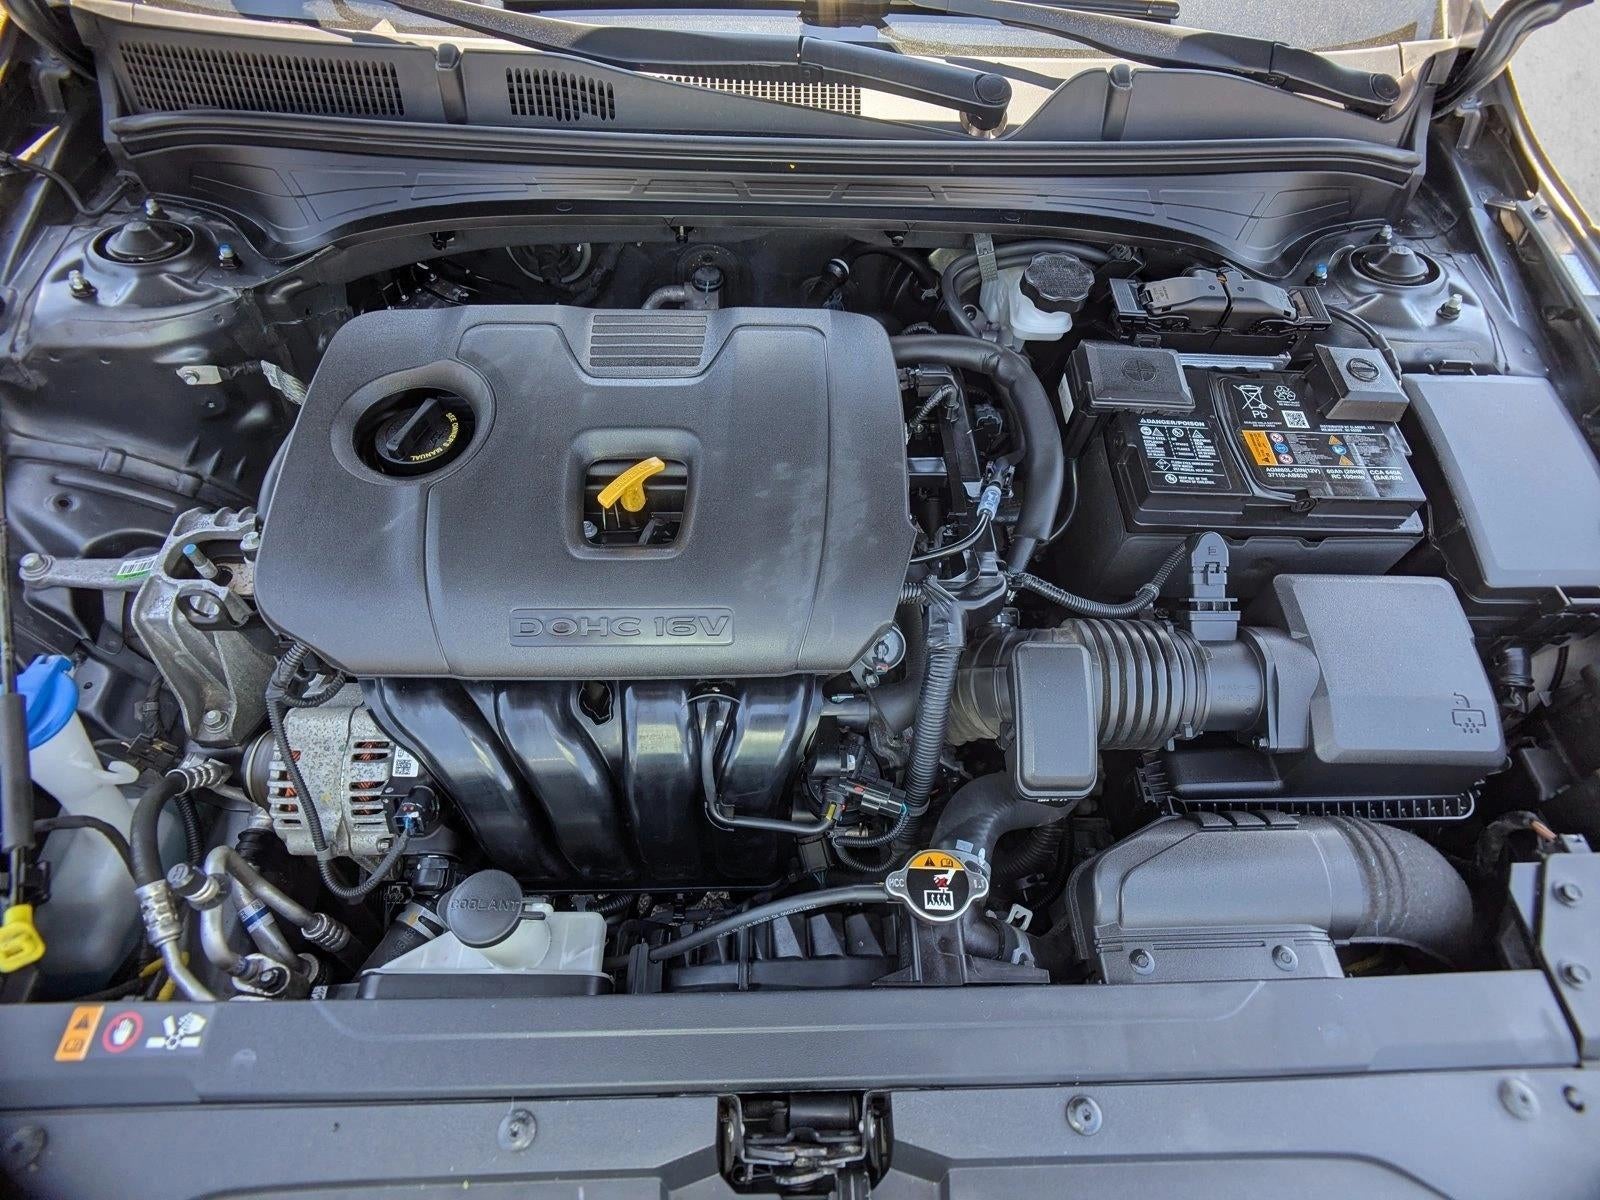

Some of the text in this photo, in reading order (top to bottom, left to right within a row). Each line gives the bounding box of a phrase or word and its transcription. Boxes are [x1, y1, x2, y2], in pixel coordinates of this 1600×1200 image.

[446, 412, 457, 422] SEE
[1252, 410, 1268, 418] Pb
[1146, 418, 1205, 427] DANGER/POISON
[442, 422, 458, 447] OWNER'S
[410, 447, 443, 461] MANUAL
[512, 616, 729, 637] DOHC 16V
[450, 897, 520, 912] COOLANT
